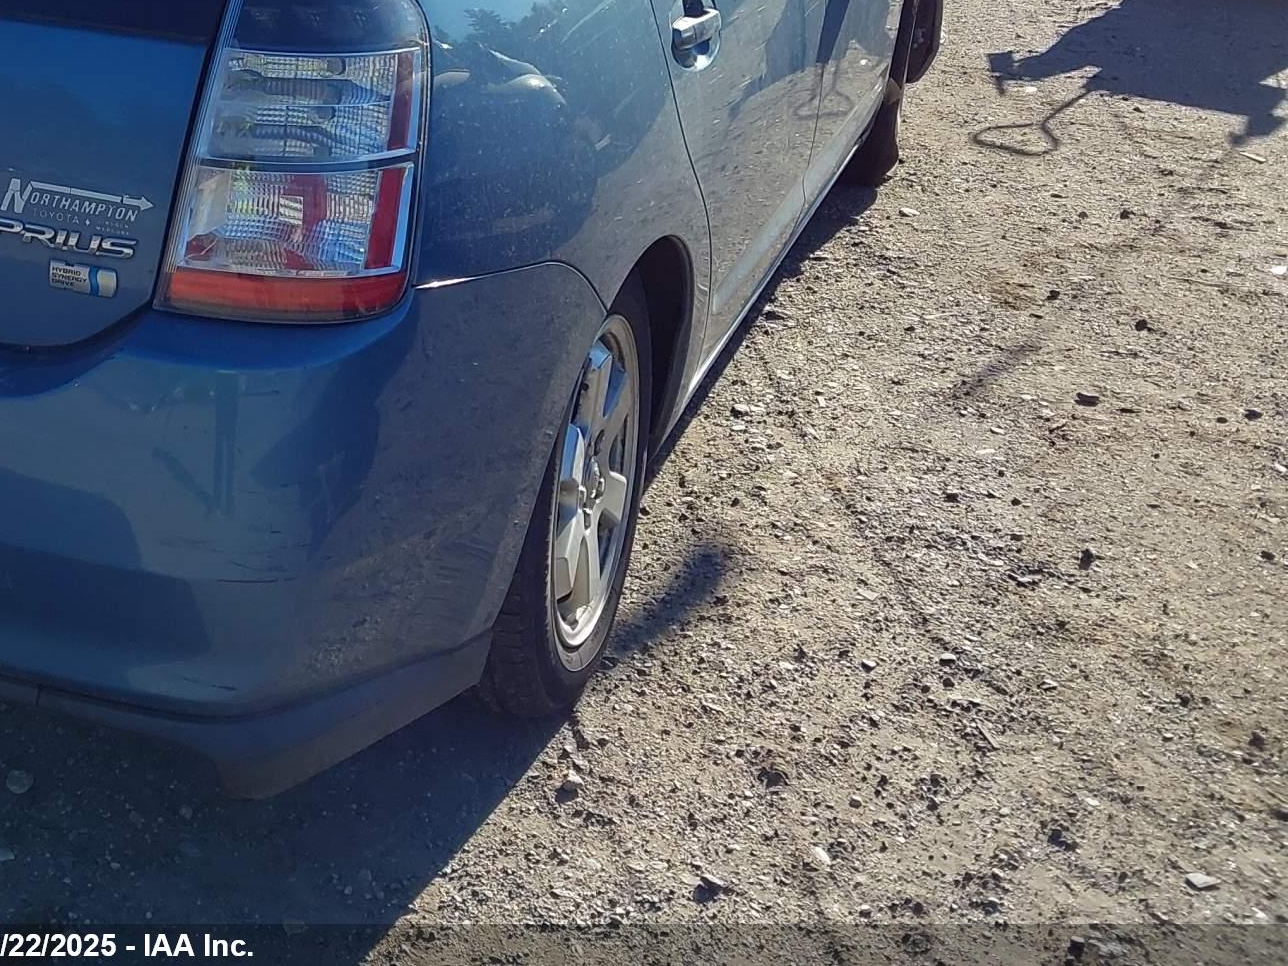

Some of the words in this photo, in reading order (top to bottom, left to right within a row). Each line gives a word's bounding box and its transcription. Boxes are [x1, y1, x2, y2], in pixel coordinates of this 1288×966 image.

[32, 208, 80, 226] TOYOTA
[52, 265, 81, 277] HYBRID
[52, 272, 87, 283] SYNERGY
